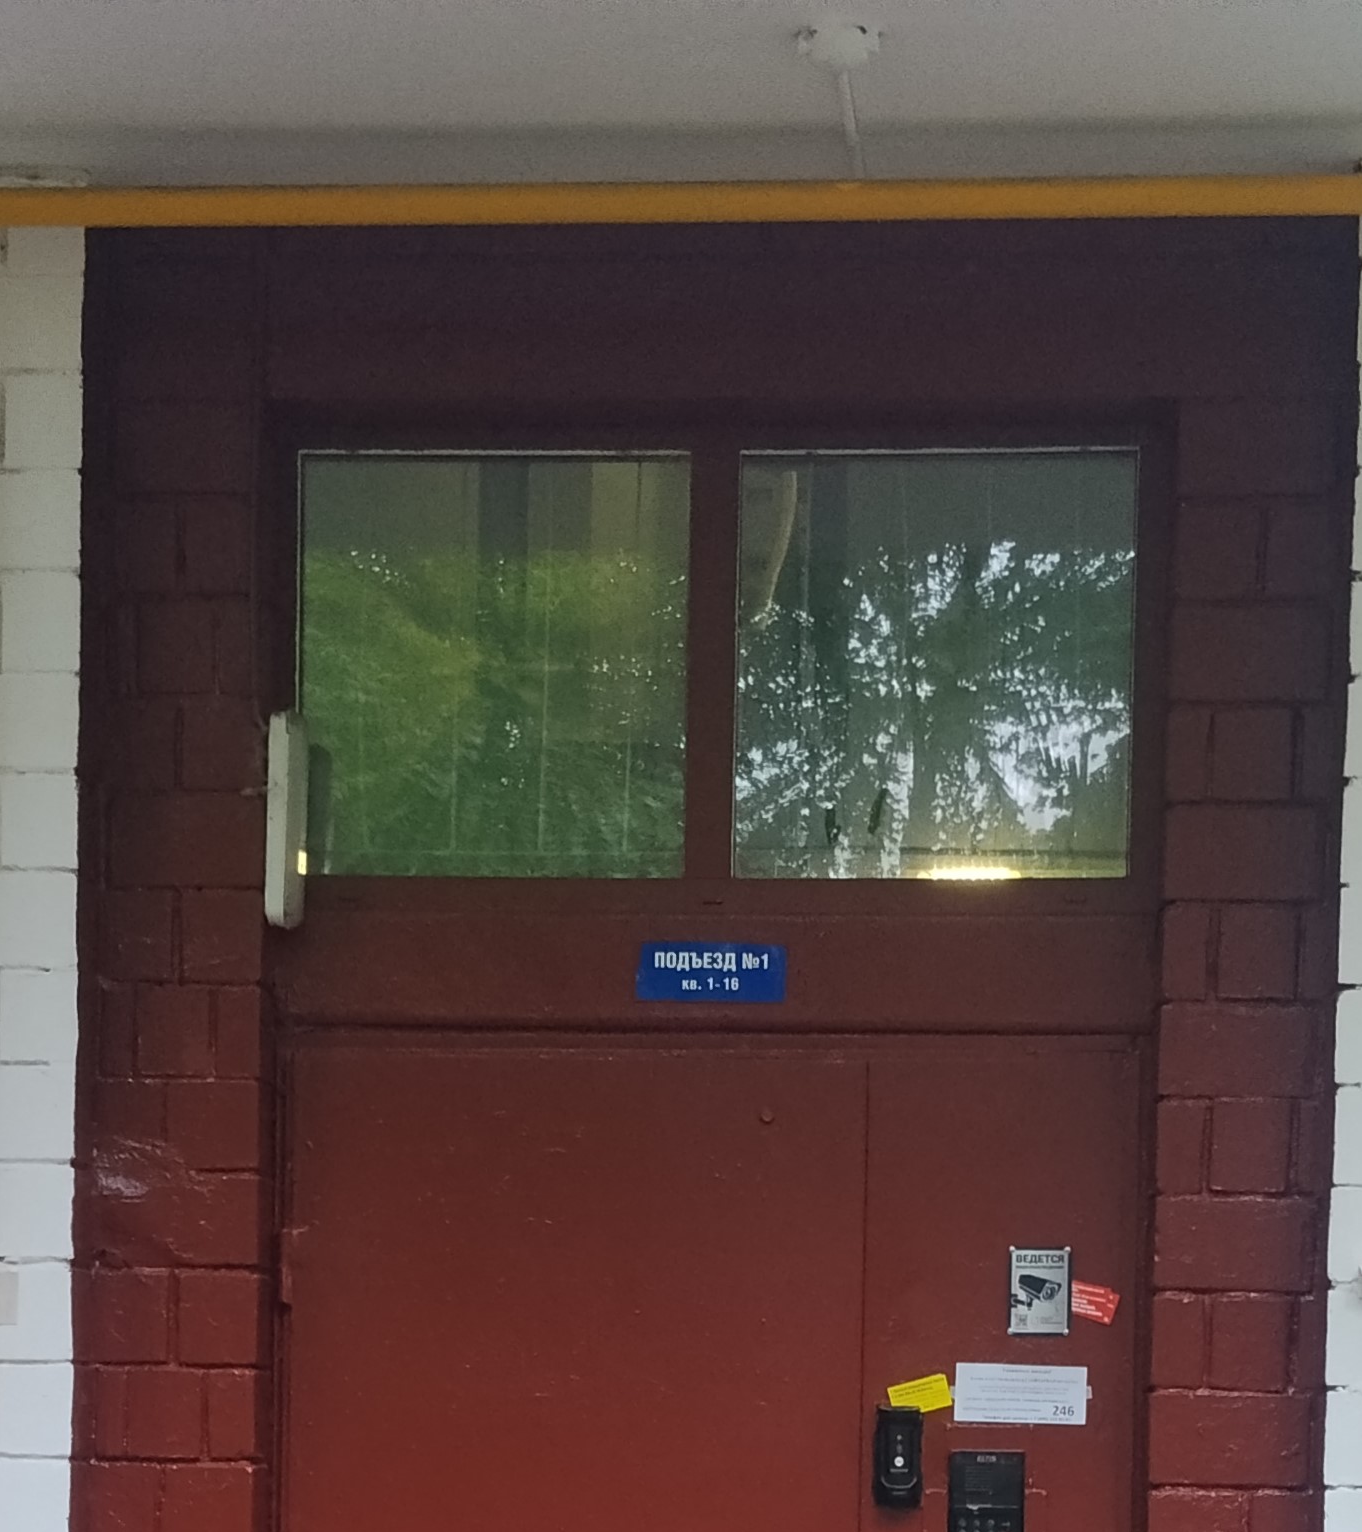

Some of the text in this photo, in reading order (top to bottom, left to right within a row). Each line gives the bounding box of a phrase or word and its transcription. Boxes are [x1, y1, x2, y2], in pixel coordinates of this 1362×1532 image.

[654, 952, 769, 971] ПОДЪЕЗД №1
[681, 977, 739, 991] кв. 1-16
[1016, 1254, 1065, 1264] ВЕДЕТСЯ
[1052, 1405, 1075, 1416] 246
